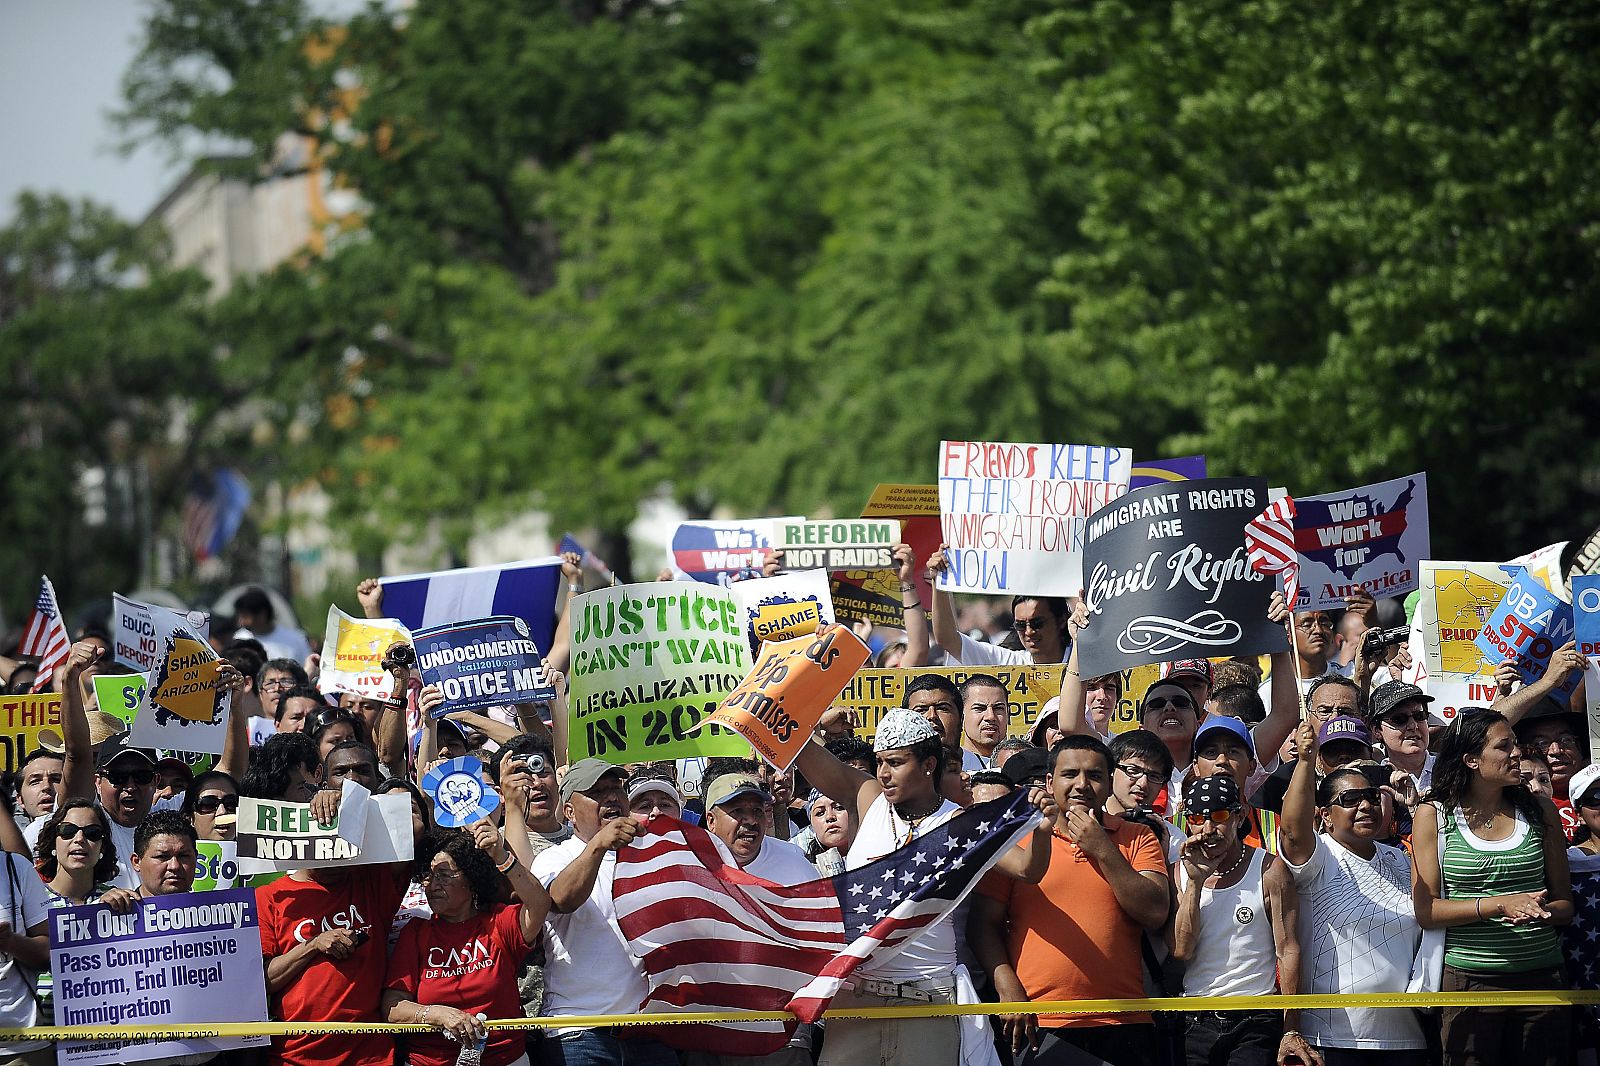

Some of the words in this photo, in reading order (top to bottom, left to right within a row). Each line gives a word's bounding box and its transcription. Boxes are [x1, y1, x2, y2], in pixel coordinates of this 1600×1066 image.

[943, 441, 1039, 479] FRIENDS
[1049, 443, 1122, 482] KEEP
[940, 477, 1021, 514] THEIR
[1089, 493, 1181, 543] IMMIGRANT
[1188, 488, 1256, 511] RIGHTS
[1328, 500, 1367, 523] We
[714, 530, 752, 549] We
[785, 523, 891, 545] REFORM
[1147, 518, 1184, 540] ARE
[1316, 518, 1383, 547] Work
[702, 549, 766, 570] Work
[786, 549, 826, 568] NOT
[829, 547, 892, 568] RAIDS
[1334, 546, 1371, 568] for
[1086, 551, 1163, 615] Civil
[1166, 543, 1264, 604] Rights
[1319, 567, 1412, 600] America
[575, 590, 741, 645] JUSTICE
[831, 596, 868, 610] USTICIA
[869, 602, 896, 615] PARA
[834, 608, 849, 618] OS
[757, 608, 816, 637] SHAME
[777, 631, 795, 642] ON
[1500, 613, 1553, 659] STO
[419, 639, 539, 670] UNDOCUMENTED
[574, 640, 660, 677] CAN'T
[666, 638, 744, 668] WAIT
[160, 679, 215, 700] ARIZONA
[183, 670, 199, 681] ON
[1028, 671, 1050, 681] HRS
[576, 673, 743, 719] LEGALIZATIO
[1469, 684, 1498, 701] All
[3, 701, 61, 728] THIS
[1326, 720, 1356, 736] SEIU
[586, 715, 628, 757] IN
[256, 838, 309, 860] NOT
[56, 914, 91, 943] Fix
[96, 909, 139, 939] Our
[143, 901, 250, 933] Economy:
[294, 905, 366, 943] CASA
[59, 952, 101, 974] Pass
[105, 936, 237, 969] Comprehensive
[428, 939, 491, 968] CASA
[61, 978, 131, 1000] Reform,
[134, 968, 166, 991] End
[171, 961, 223, 988] Illegal
[426, 969, 438, 979] DE
[63, 997, 171, 1026] Immigration
[65, 1039, 122, 1054] www.seiu.org
[123, 1040, 132, 1048] or
